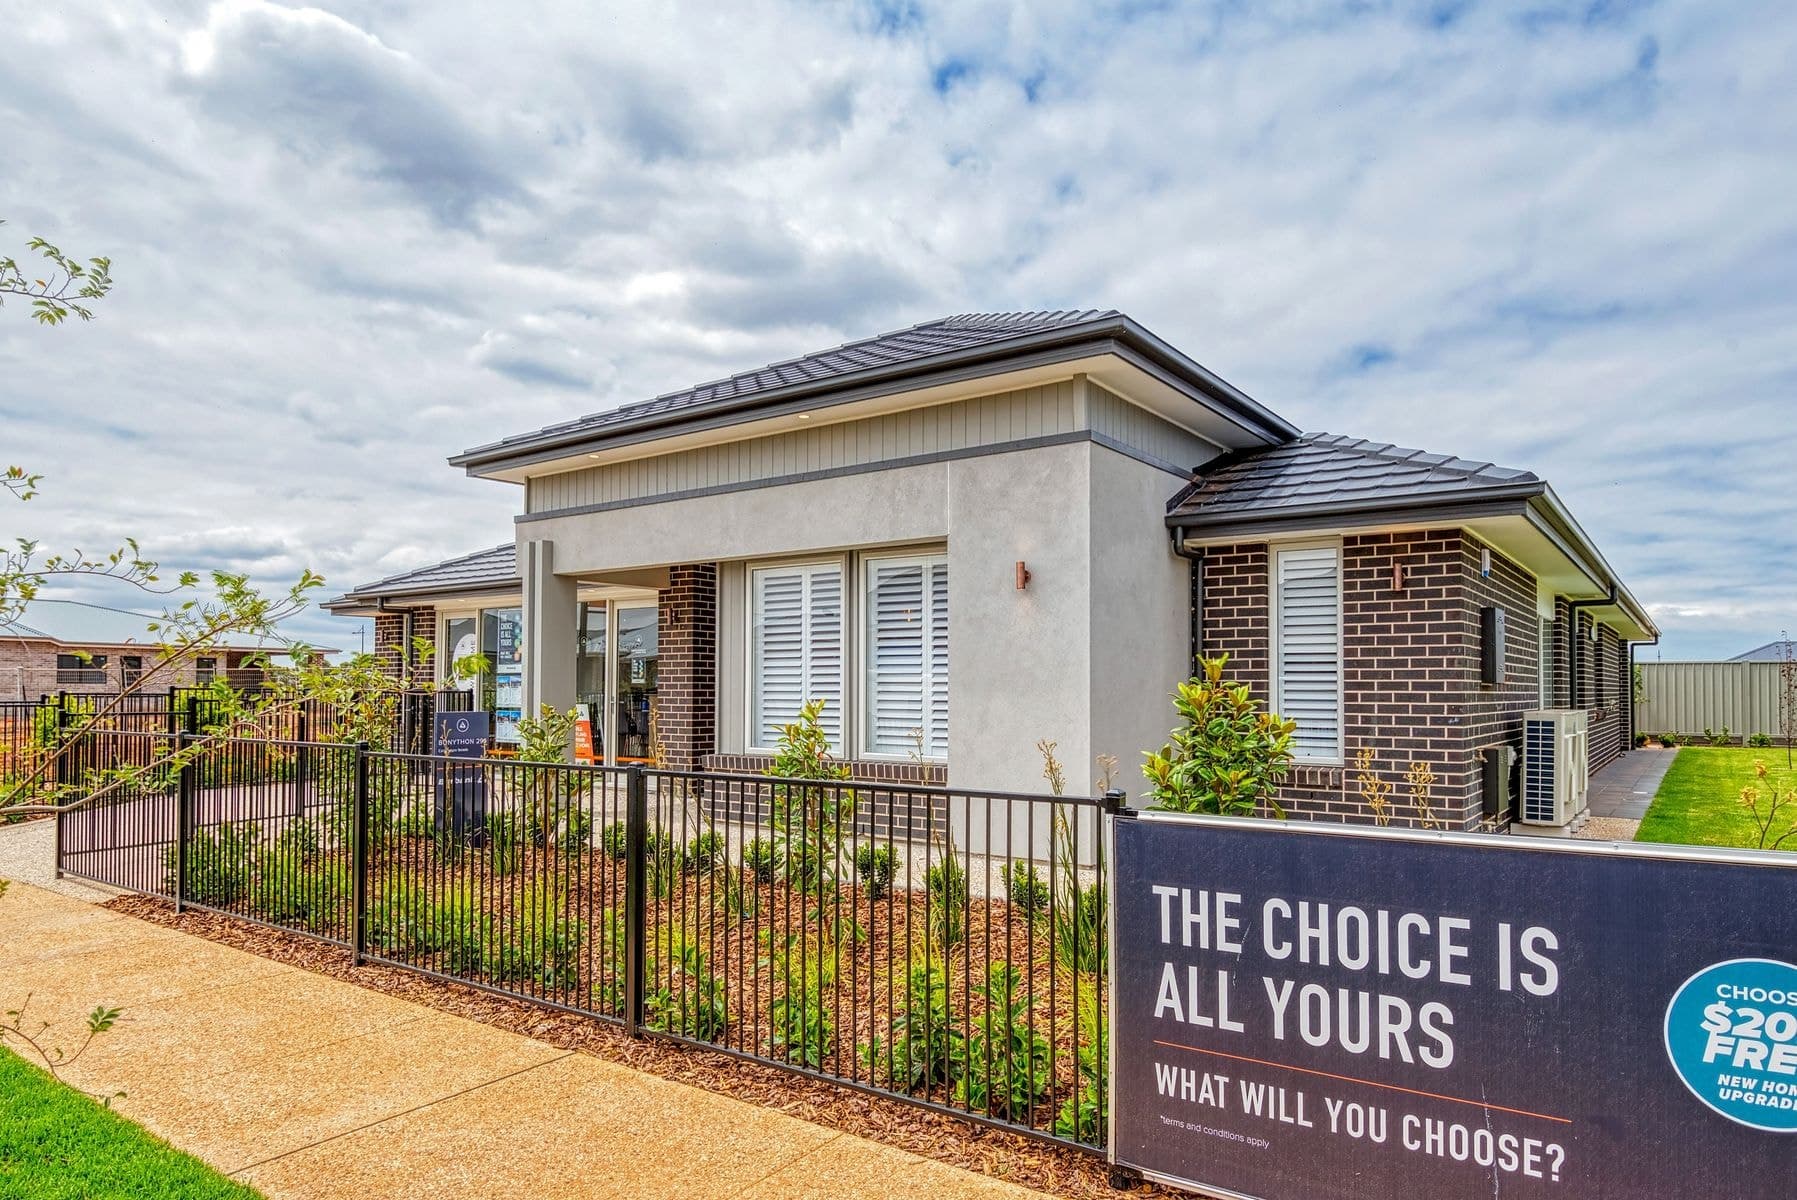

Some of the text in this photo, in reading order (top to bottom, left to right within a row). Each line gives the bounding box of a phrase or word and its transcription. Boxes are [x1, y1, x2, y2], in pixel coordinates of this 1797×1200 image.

[438, 738, 475, 746] BONYTHON
[1152, 885, 1559, 996] THE CHOICE IS
[1154, 962, 1454, 1069] ALL YOURS
[1702, 1031, 1797, 1075] FRE
[1717, 1074, 1758, 1090] NEW
[1155, 1062, 1565, 1182] WHAT WILL YOU CHOOSE?
[1186, 1123, 1202, 1132] and
[1203, 1126, 1245, 1143] conditions
[1246, 1136, 1270, 1149] apply
